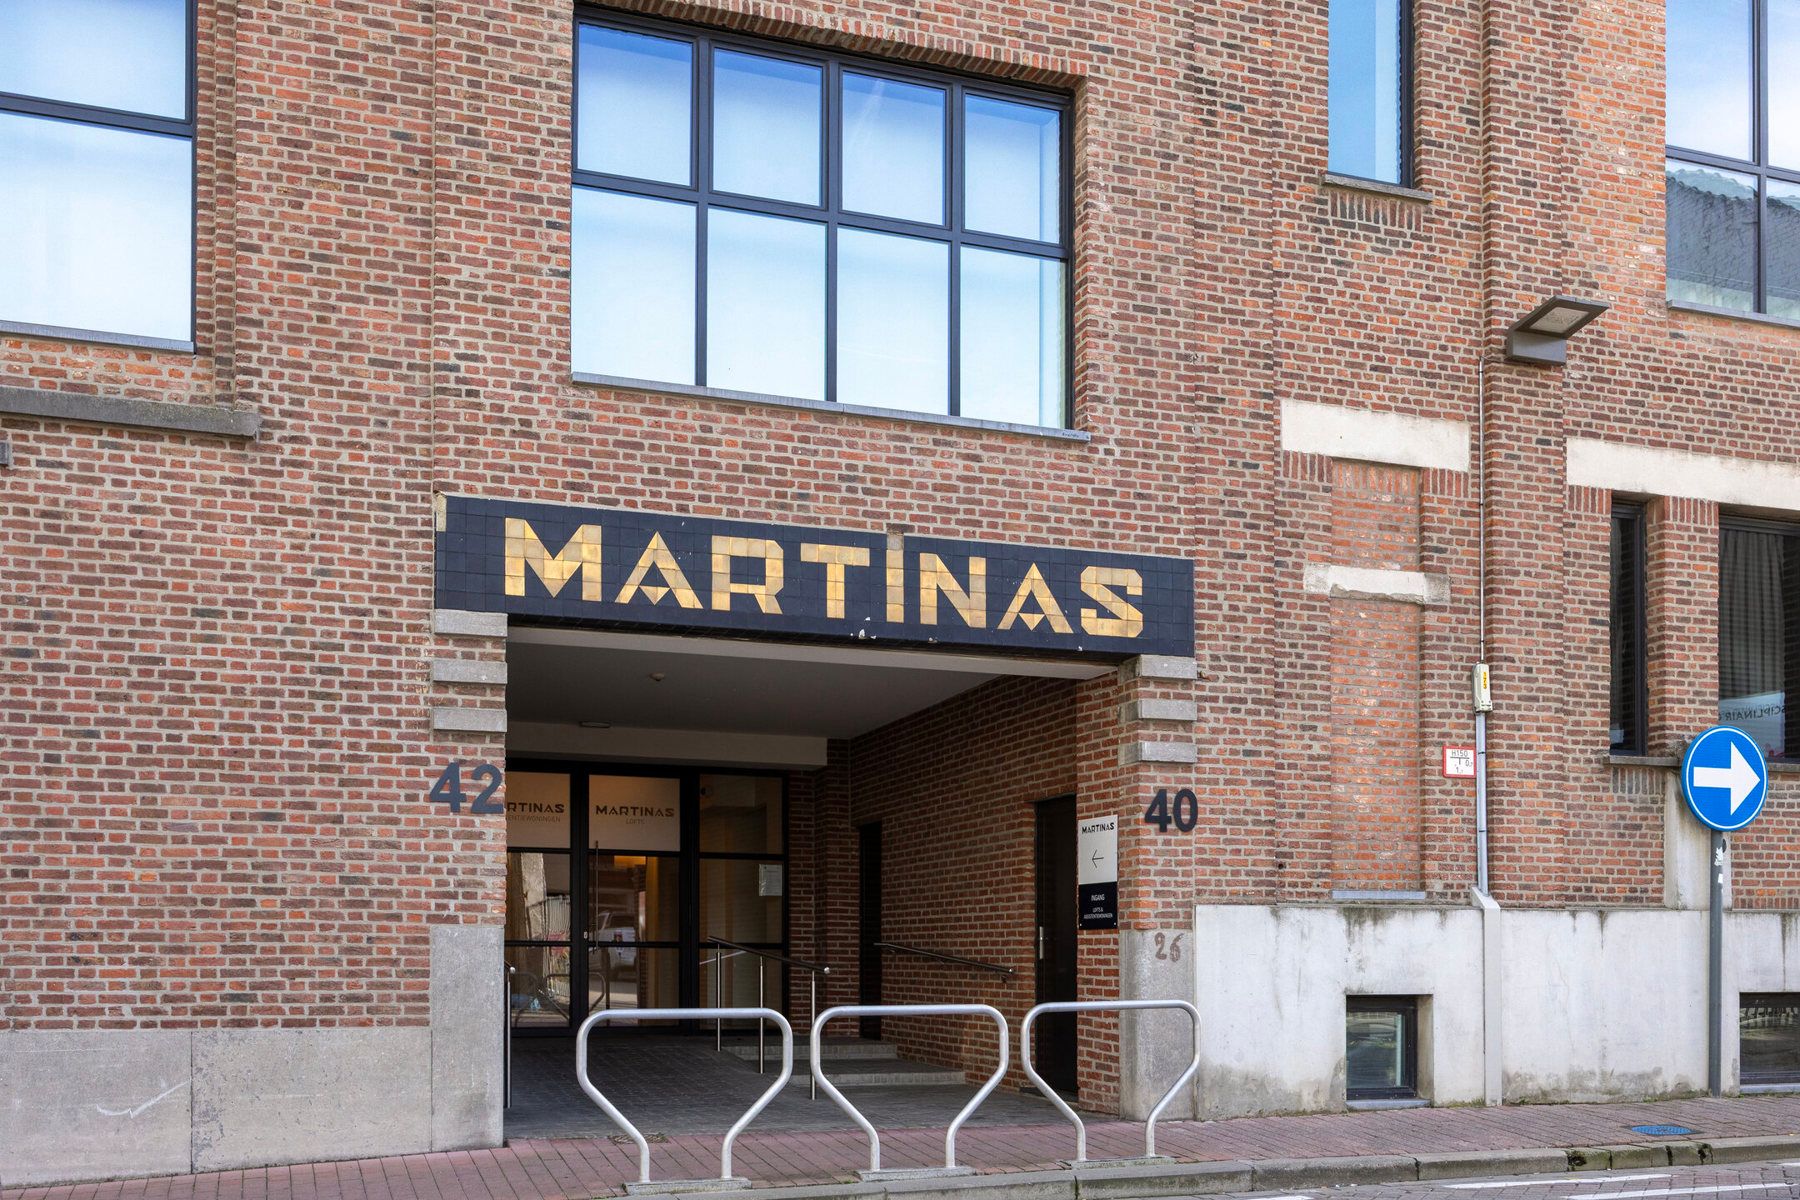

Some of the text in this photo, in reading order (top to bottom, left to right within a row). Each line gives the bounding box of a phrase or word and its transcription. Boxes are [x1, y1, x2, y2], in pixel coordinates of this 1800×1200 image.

[504, 517, 1143, 638] MARTINAS
[430, 762, 504, 814] 42
[595, 805, 675, 817] MARTINAS
[1081, 822, 1115, 834] MARTINAS
[1144, 788, 1199, 833] 40
[1154, 932, 1184, 963] 26
